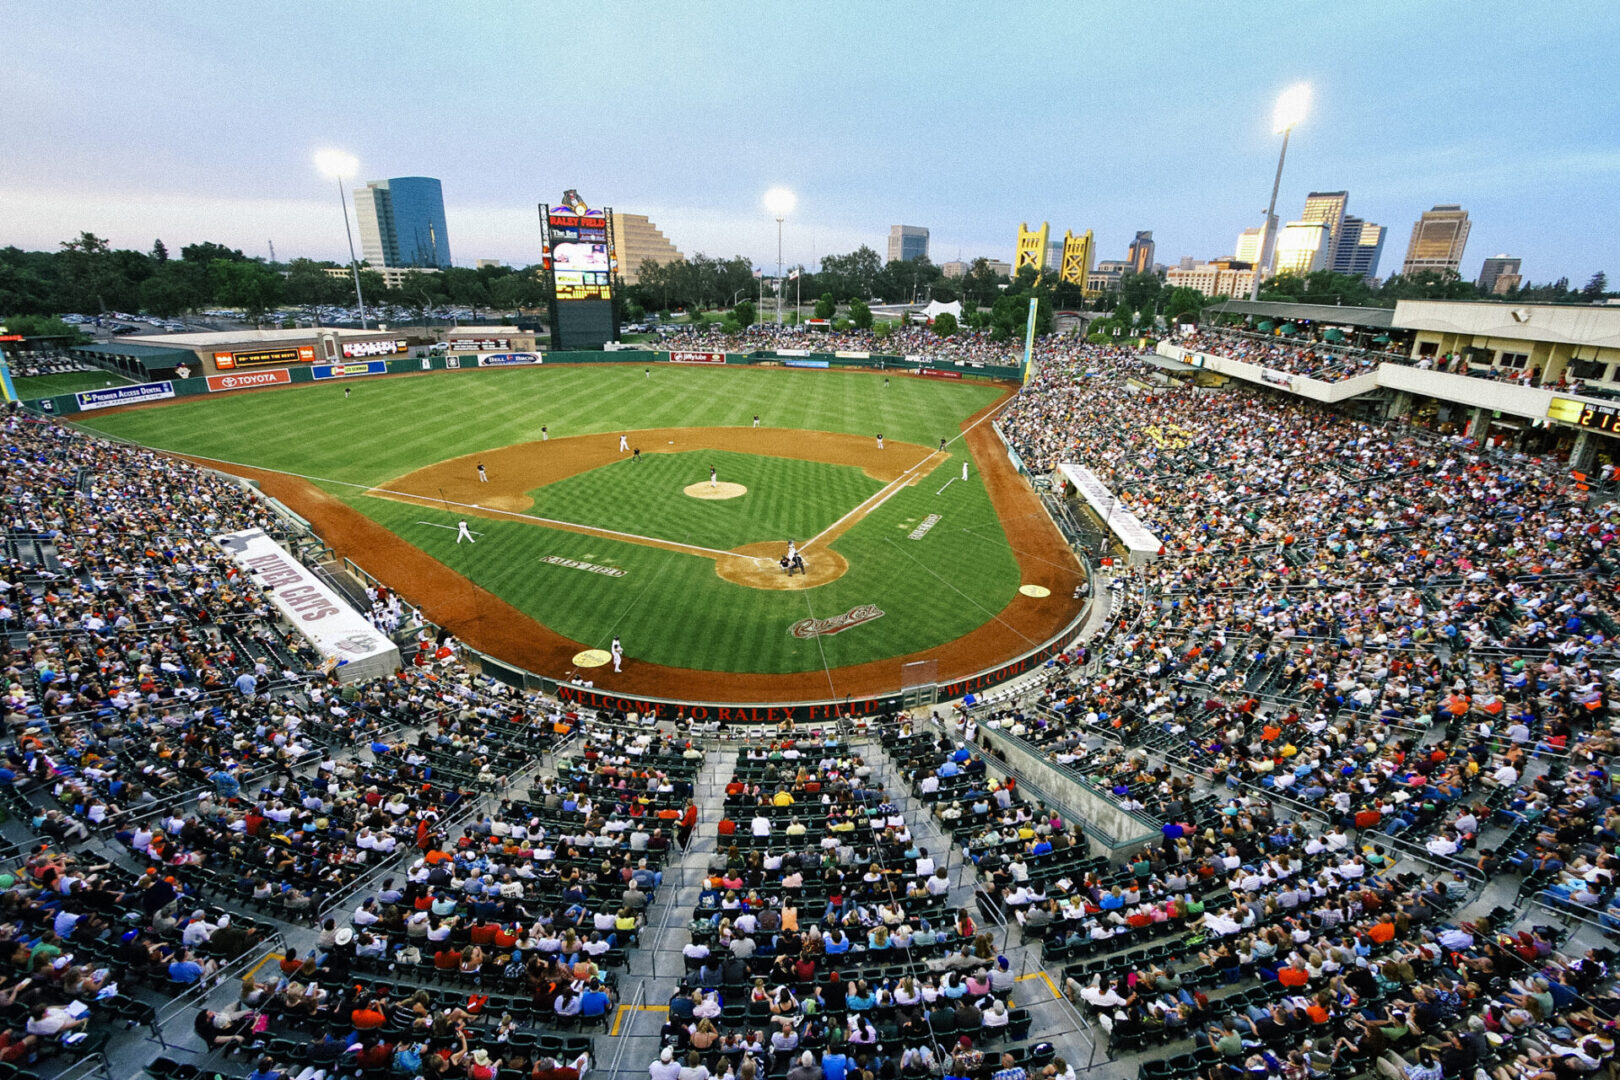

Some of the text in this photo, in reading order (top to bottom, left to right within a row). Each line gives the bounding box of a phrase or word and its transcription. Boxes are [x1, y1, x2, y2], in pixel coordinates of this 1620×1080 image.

[550, 216, 606, 228] RALEY FIELD
[237, 373, 278, 385] TOYOTA
[91, 387, 163, 402] PREMIER ACCESS DENTAL
[1581, 410, 1593, 425] 2
[1601, 414, 1609, 428] 1
[246, 553, 340, 621] RIVER CATS
[947, 660, 1028, 698] WELCOME
[558, 686, 879, 722] WELCOME TO RALEY FIELD
